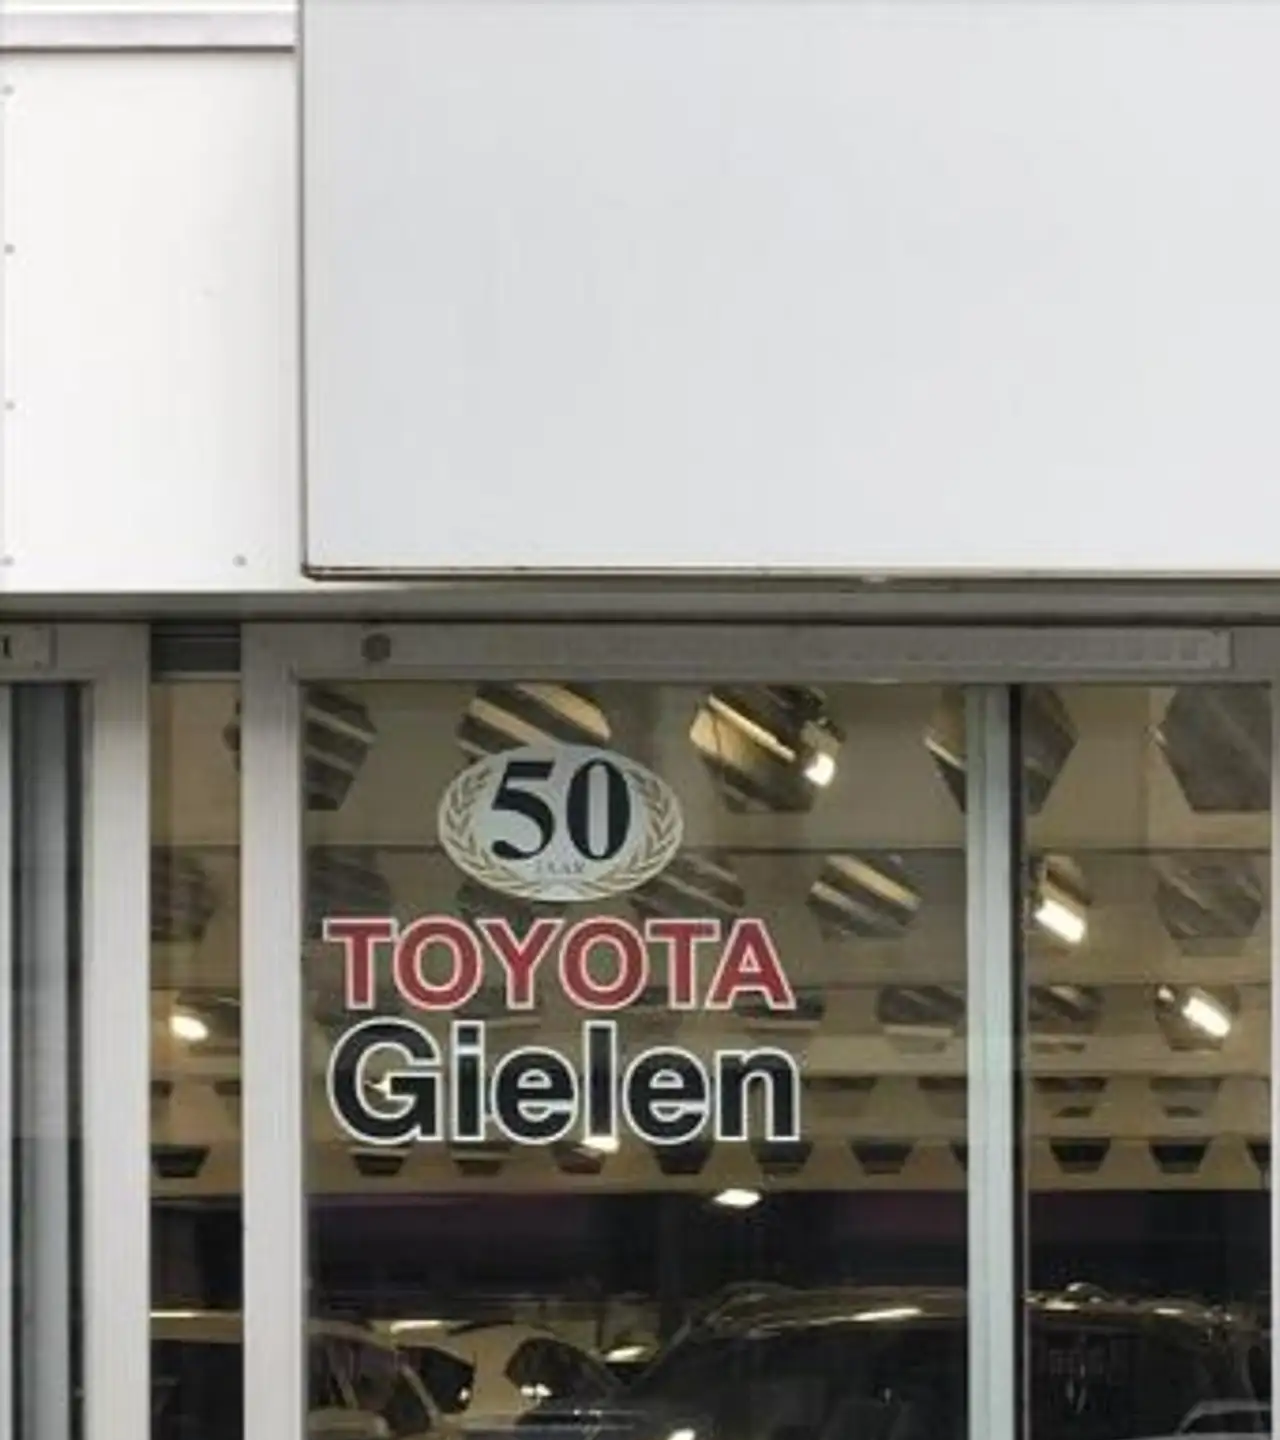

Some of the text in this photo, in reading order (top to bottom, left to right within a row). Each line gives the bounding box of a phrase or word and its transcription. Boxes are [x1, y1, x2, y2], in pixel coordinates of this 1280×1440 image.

[491, 757, 632, 861] 50
[323, 915, 797, 1011] TOYOTA
[326, 1016, 802, 1146] Gielen
